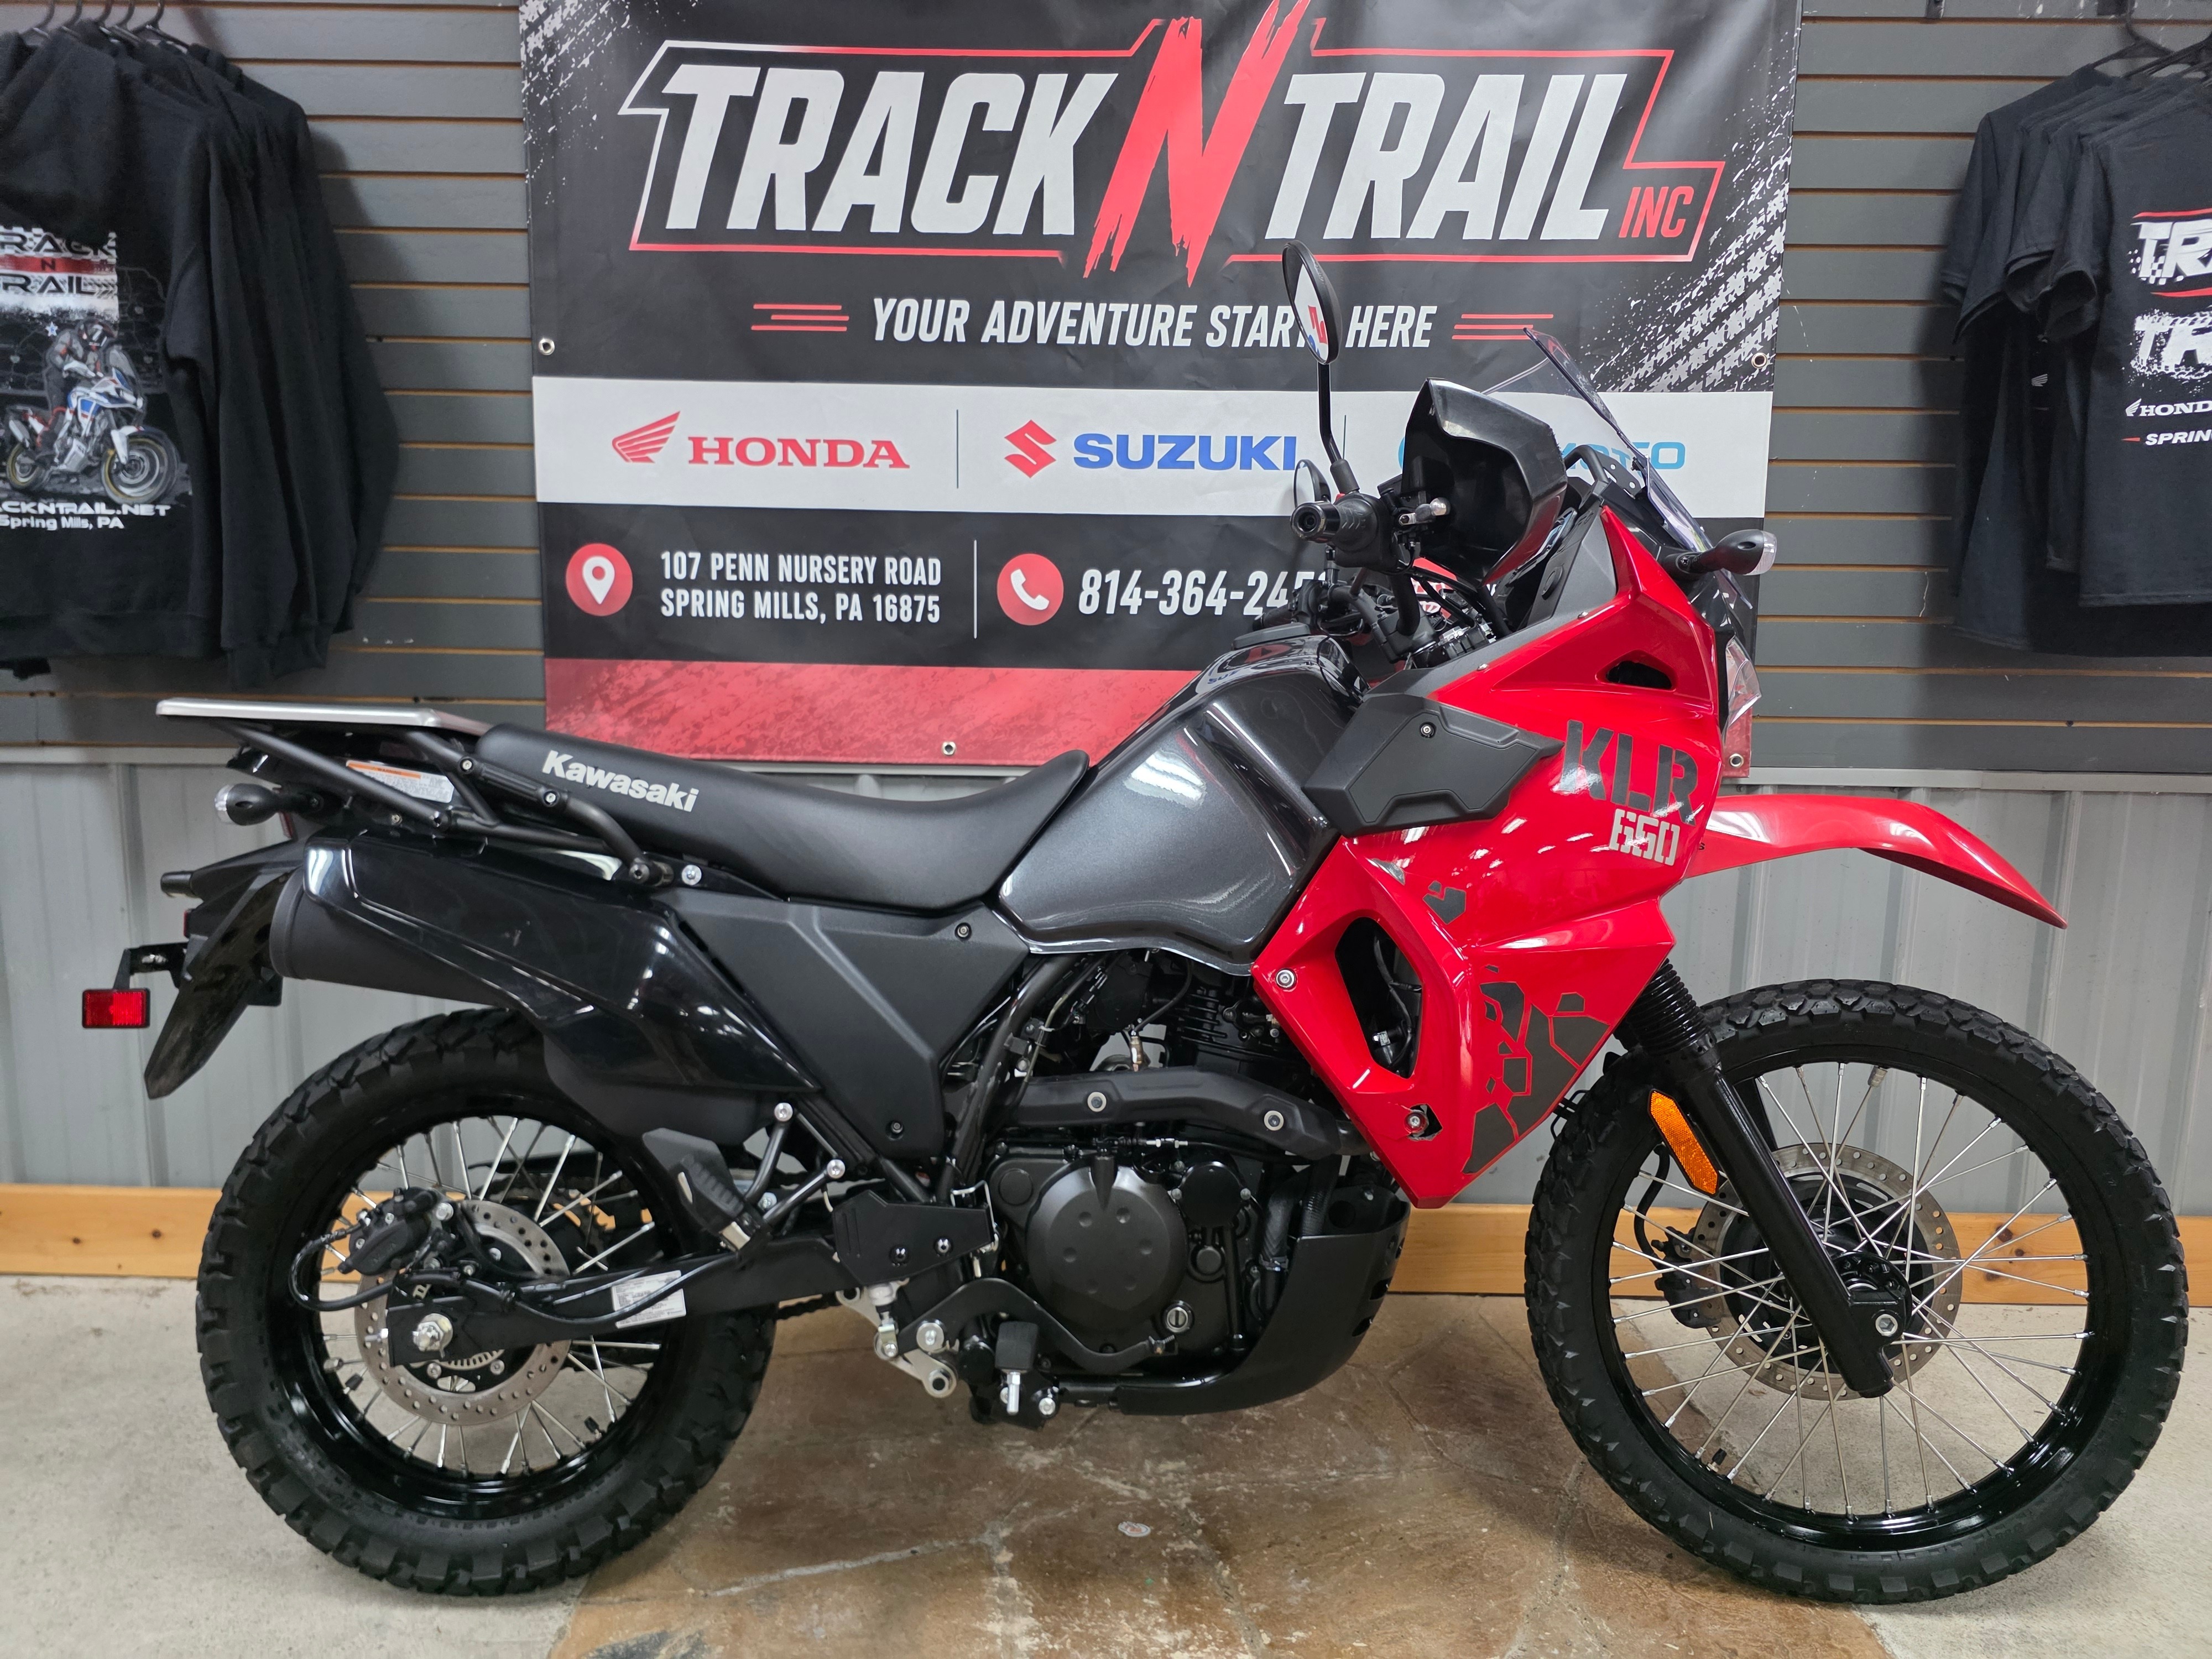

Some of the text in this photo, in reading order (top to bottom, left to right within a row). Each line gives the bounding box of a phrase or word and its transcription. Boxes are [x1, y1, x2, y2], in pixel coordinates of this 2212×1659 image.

[662, 0, 1694, 288] TRACK N TRAIL INC
[874, 298, 1438, 348] YOUR ADVENTURE STAR HERE
[688, 436, 910, 469] HONDA
[1073, 433, 1297, 471] SUZUKI
[2145, 429, 2212, 446] SPRIN
[0, 500, 171, 516] CKNTRAIL.NET
[60, 516, 93, 530] Mills,
[97, 516, 125, 529] PA
[661, 551, 941, 586] 107 PENN NURSERY ROAD
[661, 588, 940, 624] SPRING MILLS, PA 16875
[542, 750, 700, 812] Kawasaki
[1558, 719, 1698, 826] KLR
[1609, 808, 1681, 866] 650
